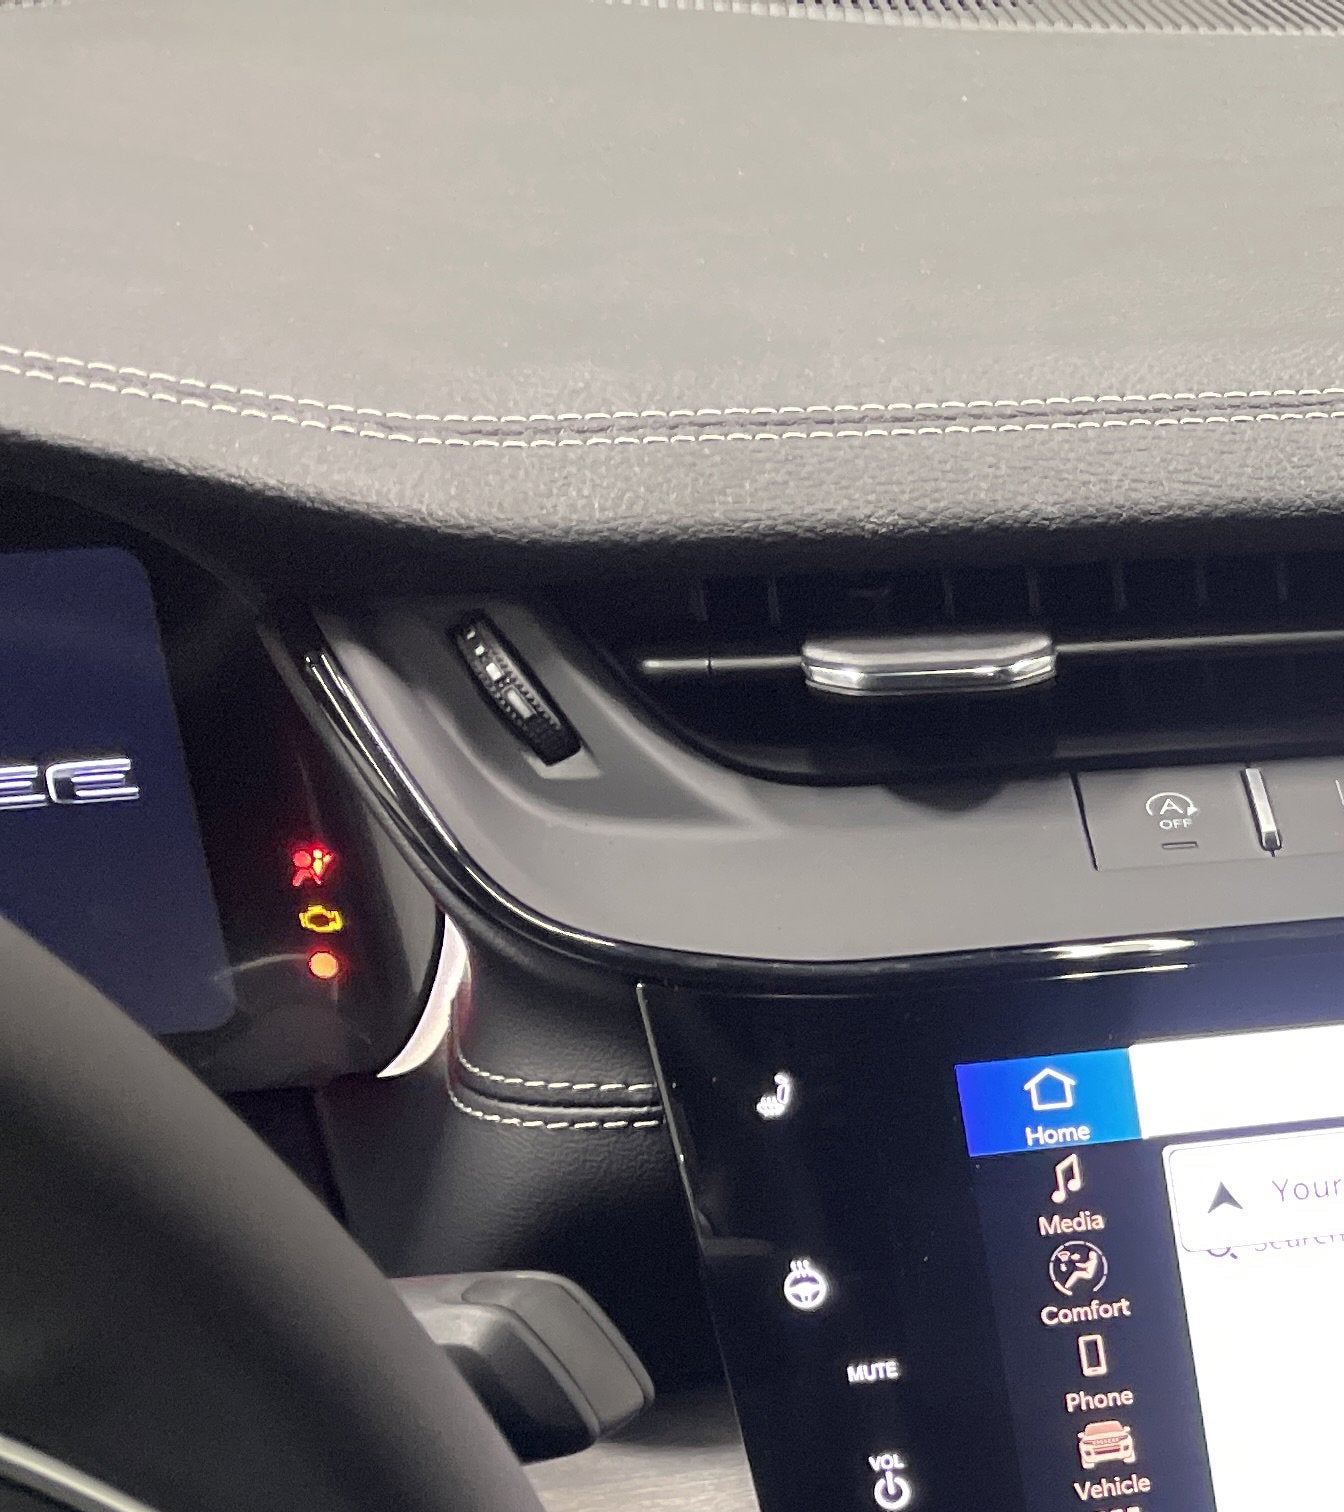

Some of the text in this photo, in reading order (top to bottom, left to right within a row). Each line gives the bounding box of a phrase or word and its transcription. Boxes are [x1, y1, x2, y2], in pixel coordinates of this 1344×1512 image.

[1159, 817, 1193, 831] OFF
[1025, 1124, 1091, 1146] Home
[1272, 1174, 1343, 1203] Your
[1038, 1211, 1105, 1236] Media
[1041, 1297, 1131, 1326] Comfort
[847, 1359, 899, 1384] MUTE
[1065, 1386, 1134, 1414] Phone
[868, 1453, 905, 1472] VOL
[1074, 1473, 1152, 1502] Vehicle
